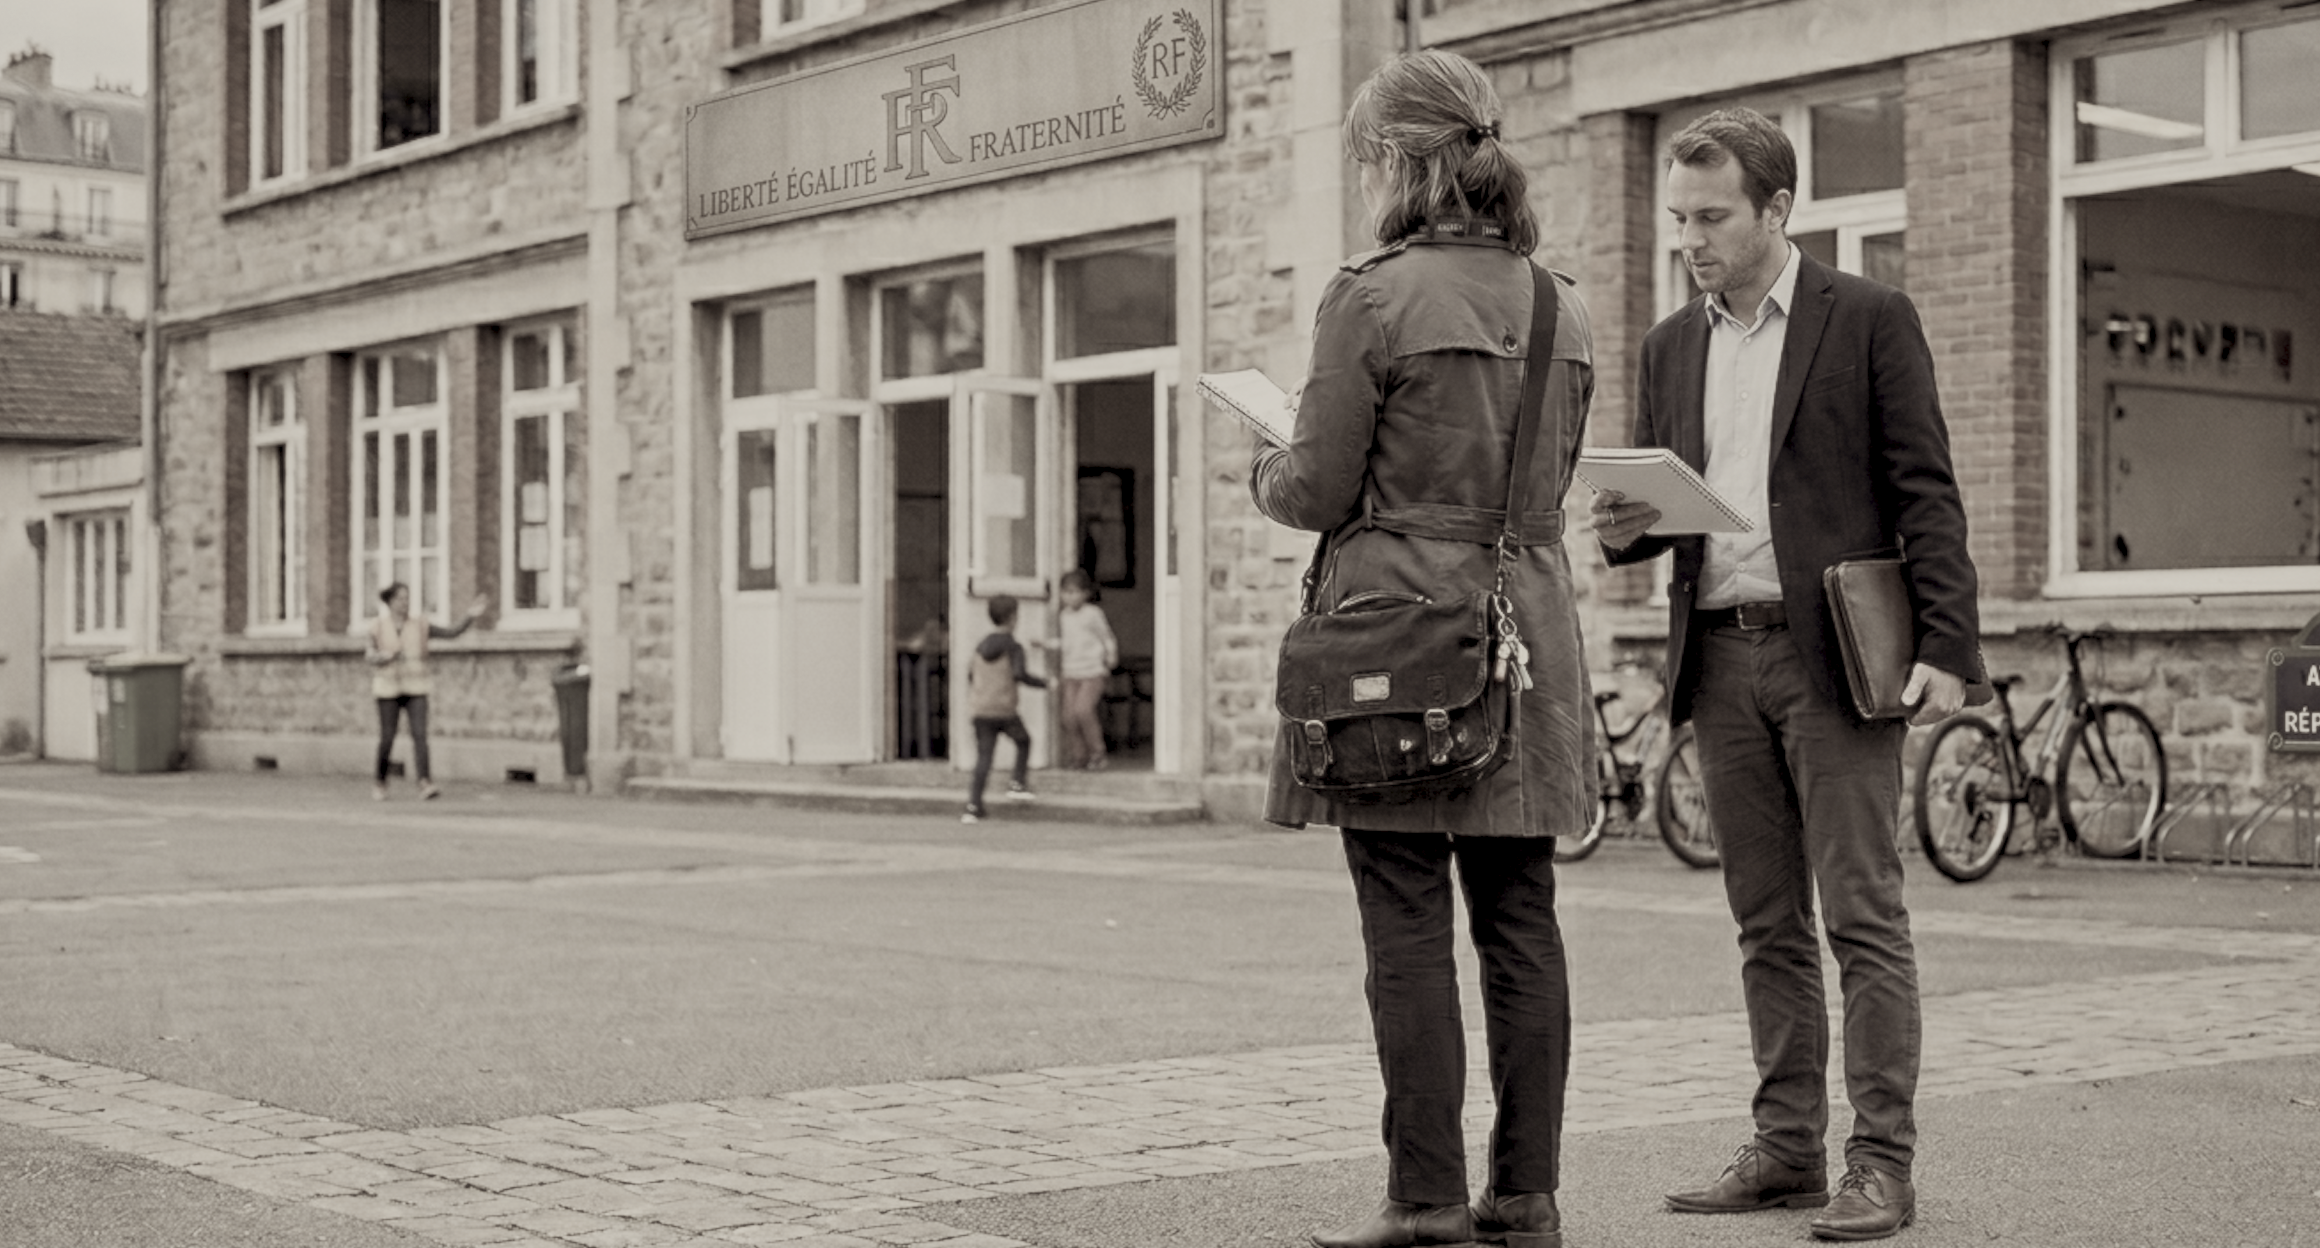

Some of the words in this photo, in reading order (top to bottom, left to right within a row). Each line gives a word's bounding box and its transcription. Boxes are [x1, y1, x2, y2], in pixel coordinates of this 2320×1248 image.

[1151, 37, 1185, 79] RF
[699, 171, 780, 218] LIBERTÉ
[786, 150, 877, 201] ÉGALITÉ
[969, 95, 1126, 163] FRATERNITÉ
[2306, 664, 2320, 686] A
